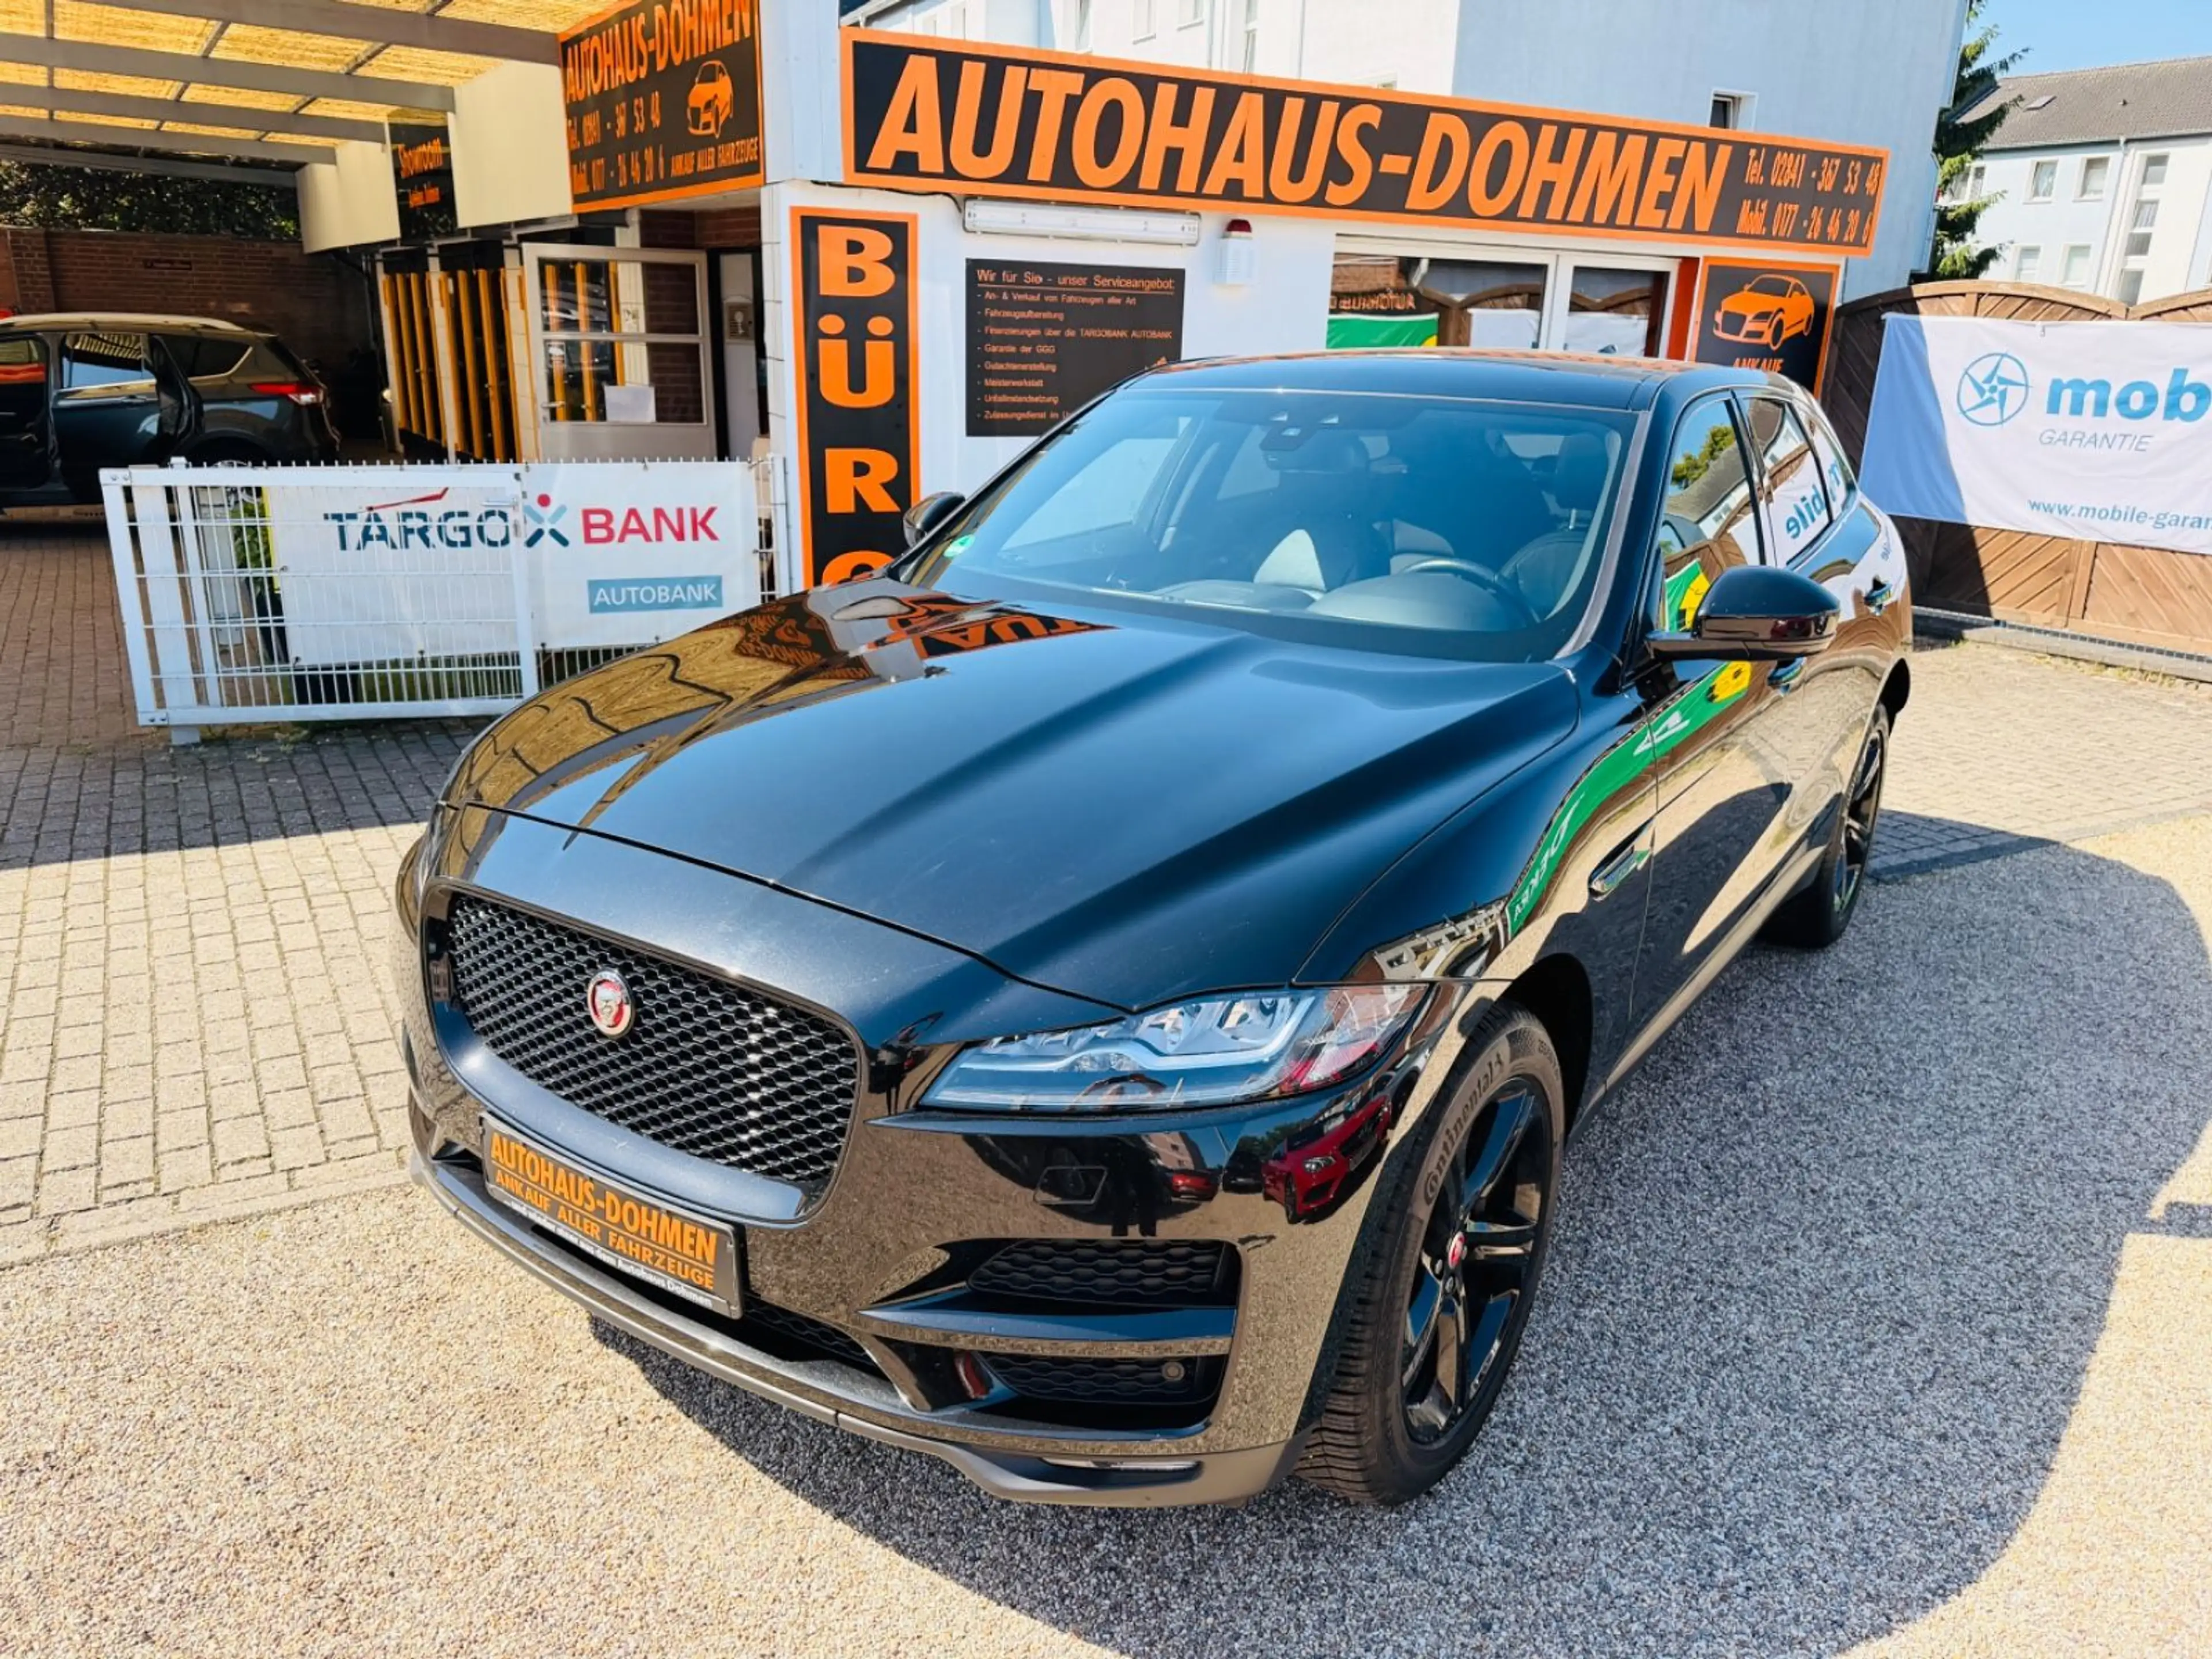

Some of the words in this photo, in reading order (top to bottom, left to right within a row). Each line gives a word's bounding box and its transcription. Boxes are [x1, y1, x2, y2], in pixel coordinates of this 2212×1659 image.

[567, 0, 751, 103] AUTOHAUS-DOHMEN
[866, 54, 1732, 232] AUTOHAUS-DOHMEN
[1744, 147, 1764, 185] Tel.
[1843, 160, 1861, 195] 53
[977, 269, 997, 283] Wir
[1002, 270, 1017, 284] für
[1024, 271, 1043, 285] Sie
[1058, 276, 1088, 287] unser
[2039, 428, 2153, 452] GARANTIE
[582, 506, 719, 543] BANK
[594, 583, 718, 607] AUTOBANK
[491, 1132, 718, 1265] AUTOHAUS-DOHMEN
[496, 1169, 551, 1212] ANKAUF
[558, 1206, 601, 1241] ALLER
[608, 1231, 715, 1290] FAHRZEUGE
[666, 1280, 713, 1308] Dohmen
